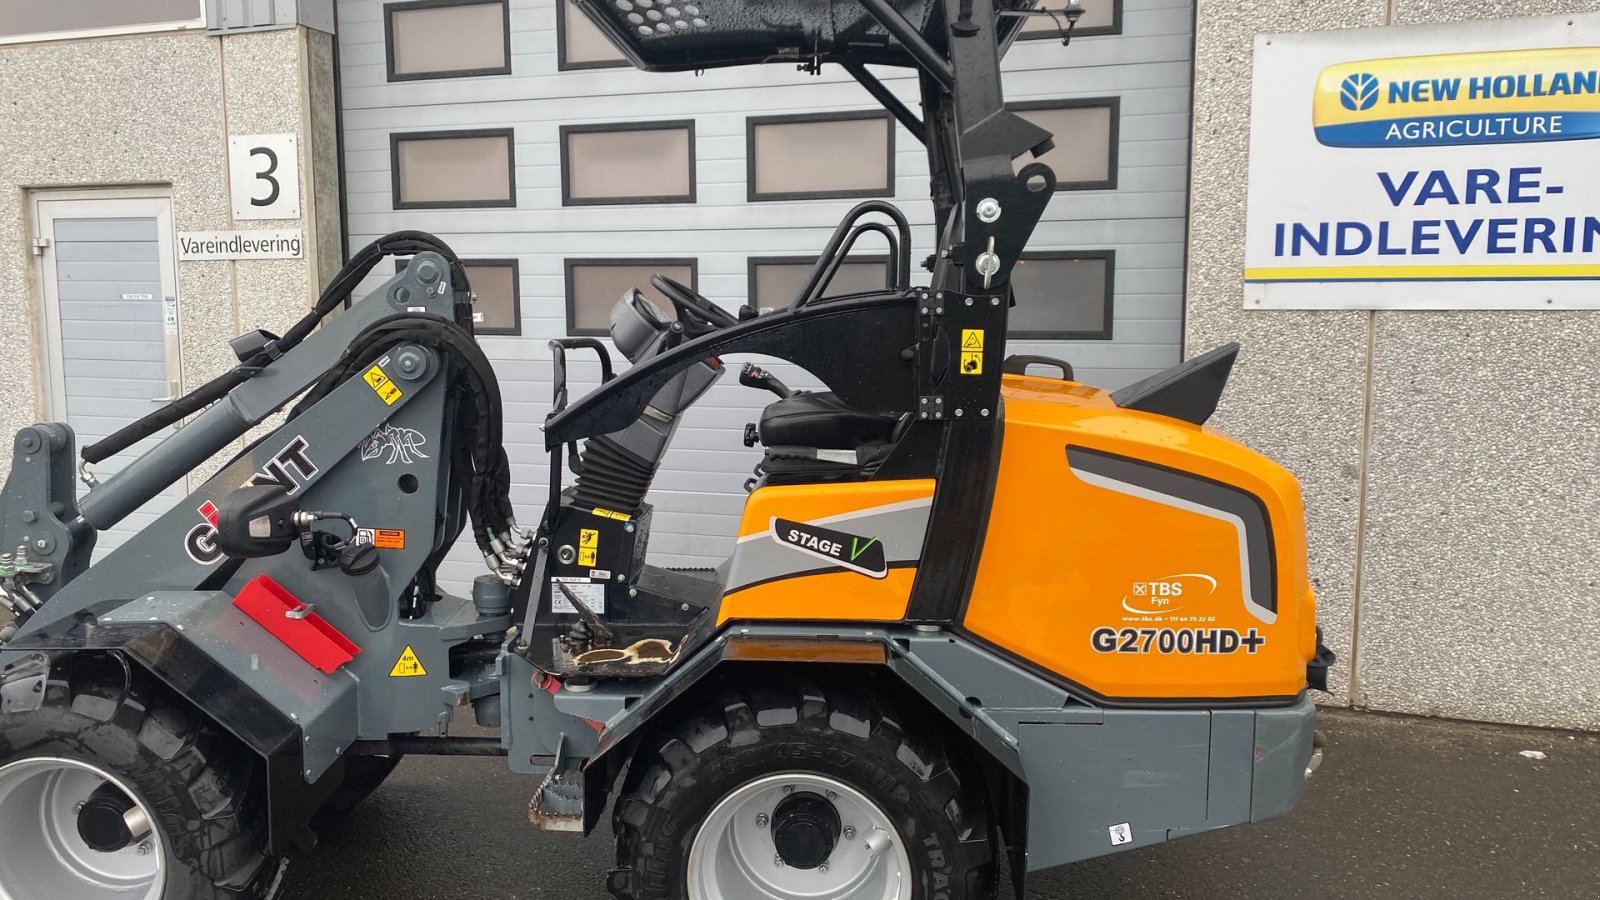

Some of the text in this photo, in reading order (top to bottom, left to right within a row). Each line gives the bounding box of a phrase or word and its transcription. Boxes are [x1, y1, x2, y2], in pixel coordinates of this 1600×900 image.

[1388, 71, 1600, 104] NEW HOLLAN
[1385, 116, 1562, 140] AGRICULTURE
[249, 147, 280, 207] 3
[1377, 167, 1564, 207] VARE-
[181, 235, 301, 256] Vareindlevering
[787, 529, 843, 556] STAGE
[1148, 582, 1182, 596] TBS
[1151, 596, 1169, 606] Fyn
[1091, 627, 1265, 654] G2700HD+
